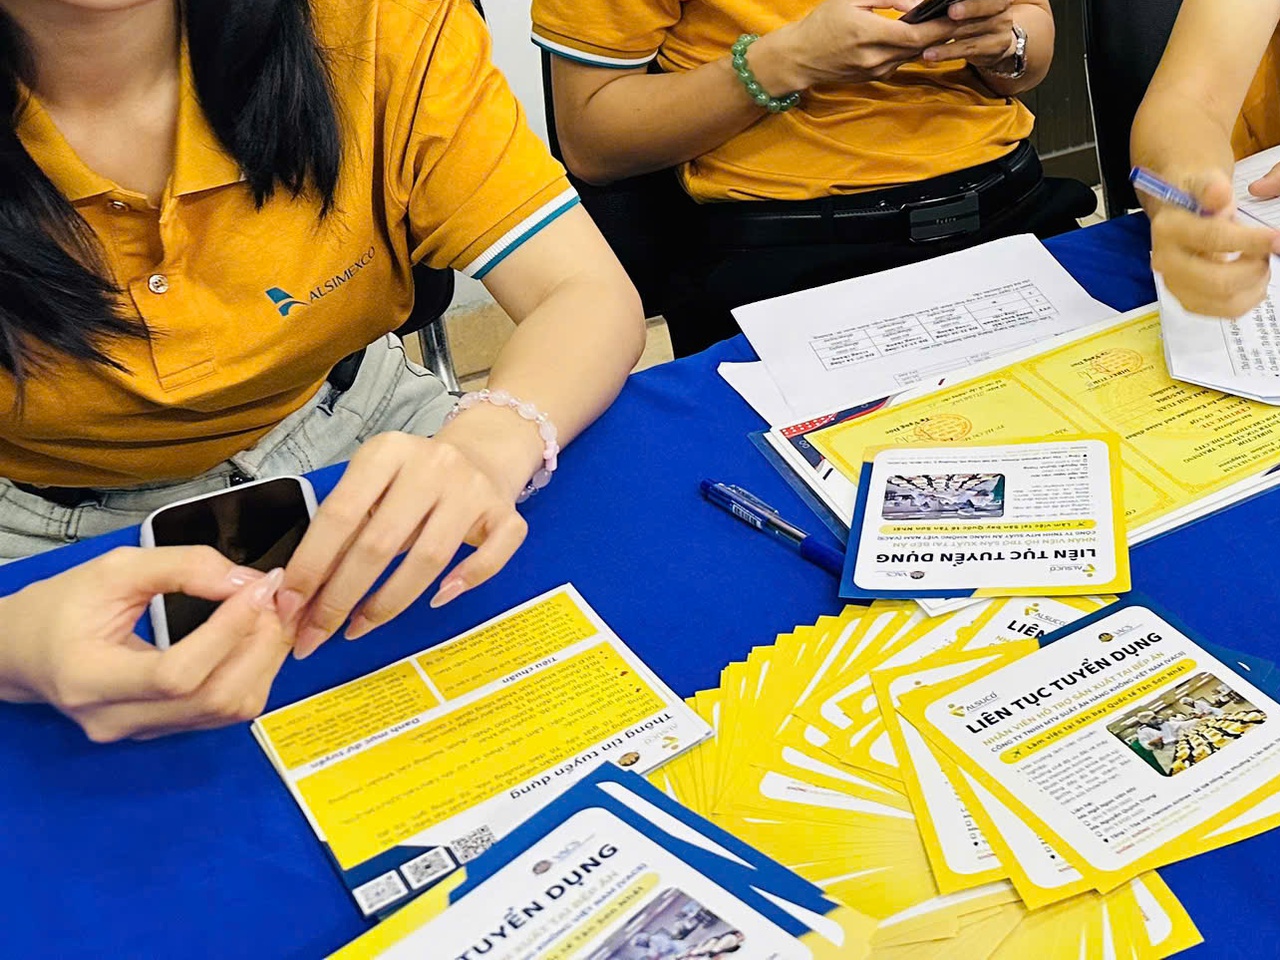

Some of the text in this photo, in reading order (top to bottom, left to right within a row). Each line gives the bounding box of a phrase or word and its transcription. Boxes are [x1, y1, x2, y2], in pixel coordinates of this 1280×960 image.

[309, 246, 376, 302] ALSIMEXCO
[876, 548, 1095, 566] LIÊN TỤC TUYỂN DỤNG
[966, 632, 1162, 733] LIÊN TỤC TUYỂN DỤNG
[510, 714, 671, 798] Thông tin tuyển dụng
[545, 843, 618, 900] DỤNG
